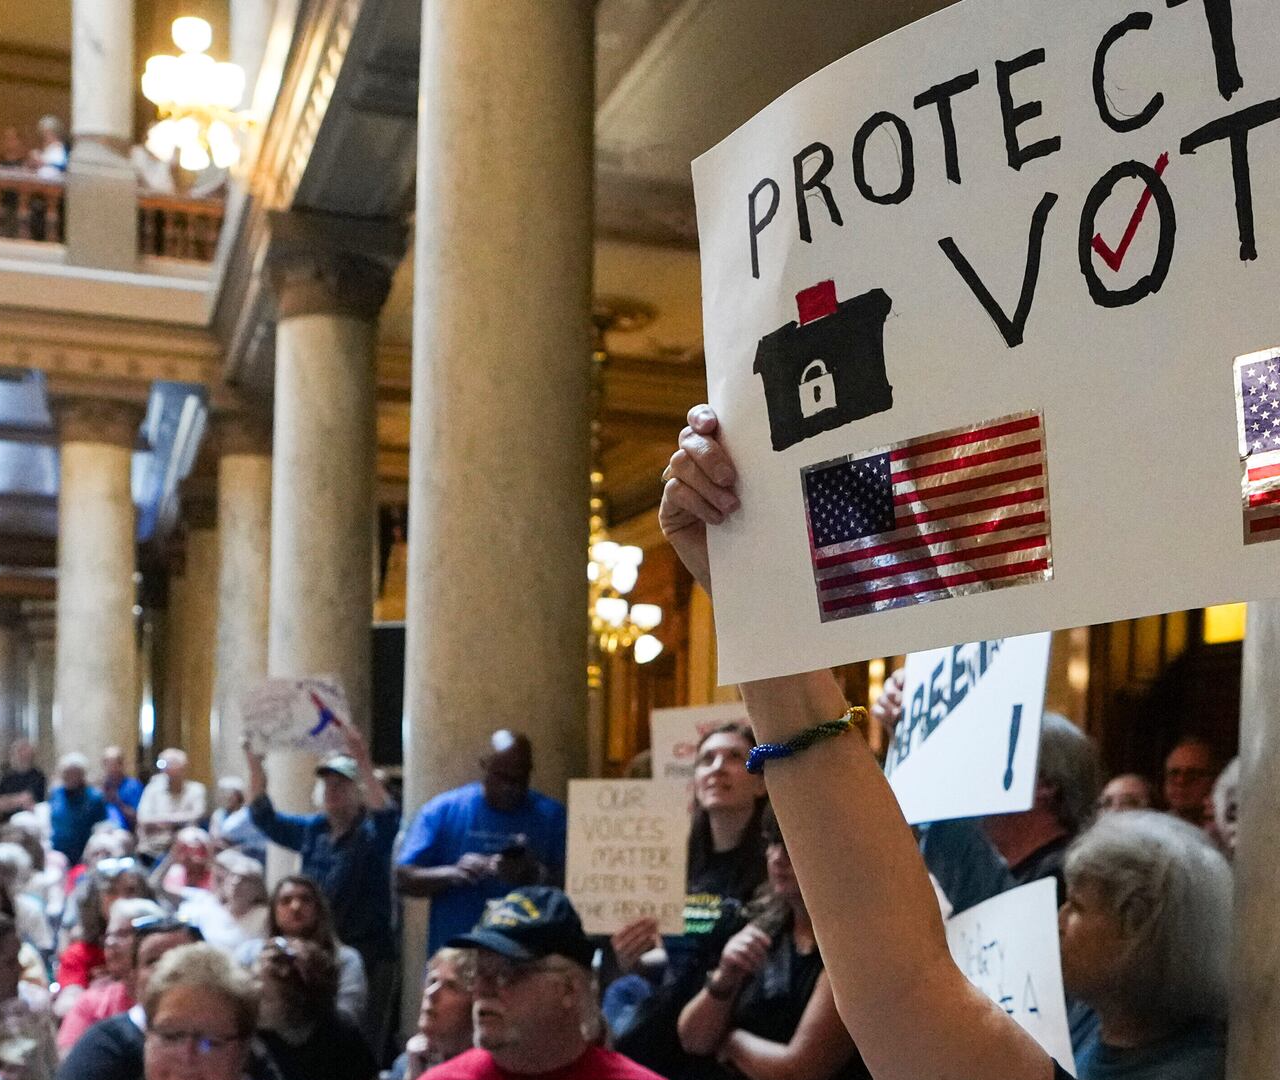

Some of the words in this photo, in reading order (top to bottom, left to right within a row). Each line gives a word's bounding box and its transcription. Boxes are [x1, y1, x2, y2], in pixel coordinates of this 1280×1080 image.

[747, 0, 1244, 279] PROTECT
[596, 784, 646, 810] OUR
[581, 815, 665, 842] VOICES
[591, 846, 672, 869] MATTER
[573, 873, 636, 895] LISTEN
[644, 874, 668, 893] TO
